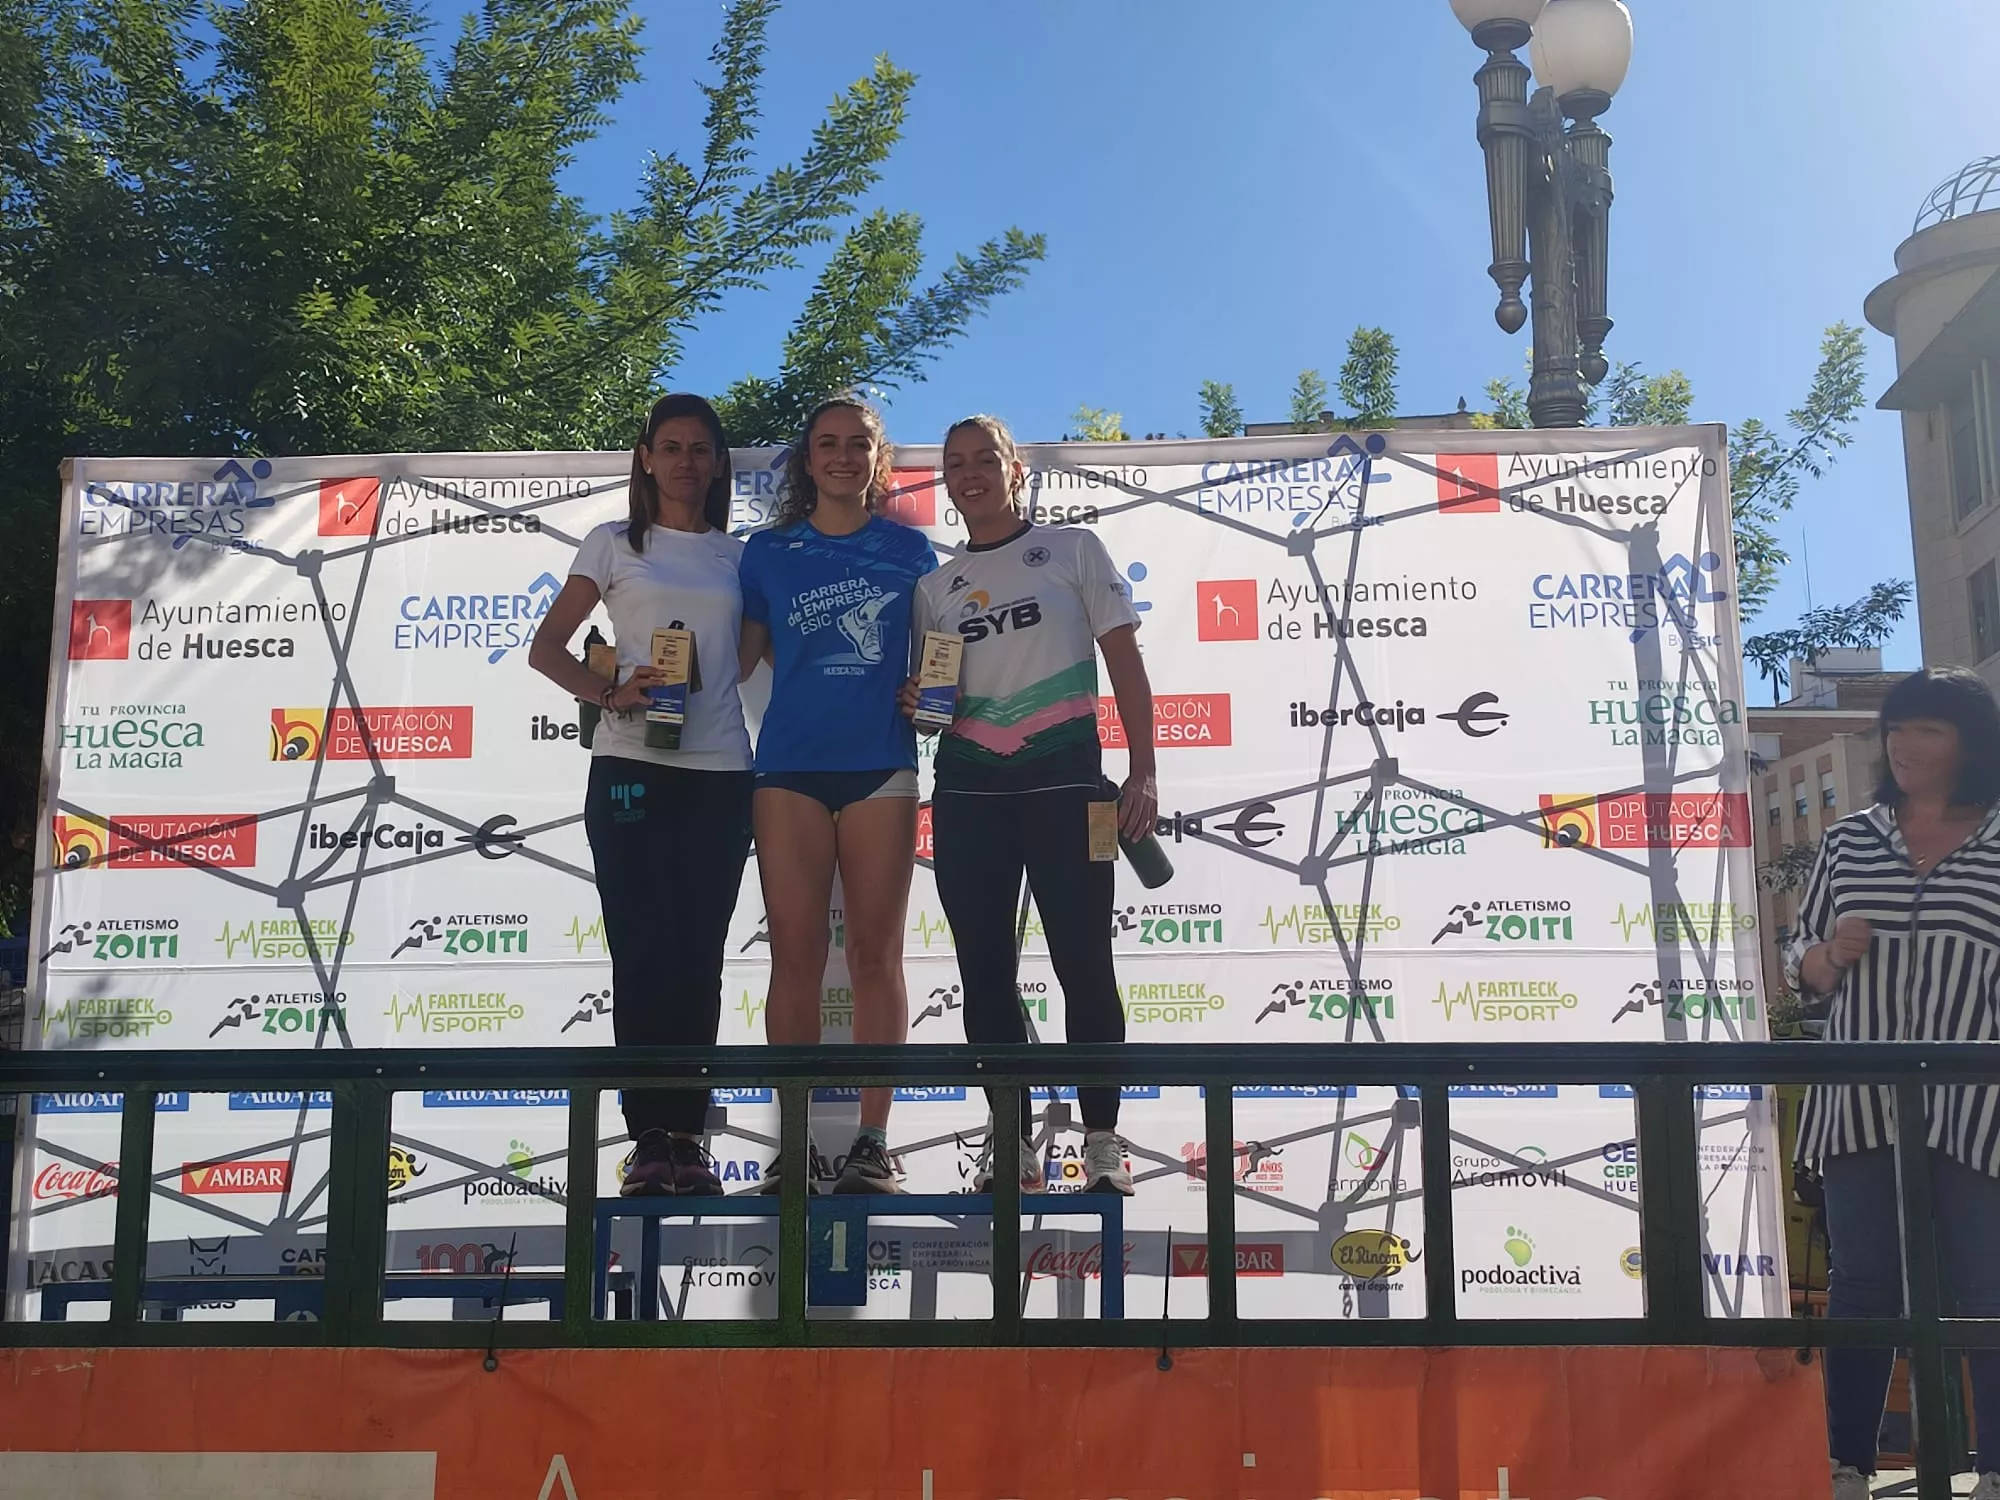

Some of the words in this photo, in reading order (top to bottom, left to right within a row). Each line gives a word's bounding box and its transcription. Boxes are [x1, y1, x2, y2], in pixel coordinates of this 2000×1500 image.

[1200, 458, 1357, 486] CARRERA
[1507, 452, 1717, 483] Ayuntamiento
[1028, 467, 1147, 489] amiento
[86, 481, 241, 507] CARRERA
[387, 475, 592, 505] Ayuntamiento
[1198, 484, 1363, 514] EMPRESAS
[1508, 491, 1543, 515] de
[1555, 487, 1667, 515] Huesca
[80, 508, 245, 535] EMPRESAS
[386, 511, 418, 535] de
[430, 509, 541, 534] Huesca
[798, 577, 870, 604] CARRERA
[1267, 576, 1477, 612] Ayuntamiento
[1532, 572, 1694, 601] CARRERA
[140, 597, 347, 631] Ayuntamiento
[787, 612, 802, 627] de
[803, 586, 883, 619] EMPRESAS
[1529, 601, 1699, 632] EMPRESAS
[800, 613, 832, 635] ESIC
[958, 602, 1042, 643] SYB
[1267, 613, 1301, 640] de
[1314, 612, 1427, 639] Huesca
[395, 622, 536, 649] EMPRESA
[138, 634, 172, 660] de
[183, 633, 294, 659] Huesca
[335, 712, 454, 733] DIPUTACIÓN
[1290, 701, 1425, 732] iberCaja
[335, 736, 363, 754] DE
[368, 735, 453, 753] HUESCA
[1608, 797, 1732, 820] DIPUTACIÓN
[118, 818, 237, 842] DIPUTACIÓN
[309, 823, 443, 854] iberCaja
[1609, 823, 1637, 841] DE
[1644, 822, 1734, 841] HUESCA
[117, 845, 144, 863] DE
[150, 843, 236, 862] HUESCA
[1141, 904, 1222, 915] ATLETISMO
[1303, 903, 1383, 921] FARTLECK
[1487, 901, 1571, 912] ATLETISMO
[1657, 903, 1737, 920] FARTLECK
[97, 920, 180, 931] ATLETISMO
[261, 920, 337, 936] FARTLECK
[446, 914, 528, 927] ATLETISMO
[1486, 915, 1573, 942] ZOITI
[444, 928, 528, 955] ZOITI
[1139, 918, 1223, 945] ZOITI
[1307, 926, 1384, 944] SPORT
[1662, 925, 1740, 944] SPORT
[93, 935, 179, 960] ZOITI
[263, 940, 335, 959] SPORT
[1129, 983, 1205, 999] FARTLECK
[1310, 979, 1394, 991] ATLETISMO
[1478, 981, 1559, 998] FARTLECK
[1667, 979, 1754, 991] ATLETISMO
[77, 998, 155, 1015] FARTLECK
[266, 993, 347, 1004] ATLETISMO
[429, 993, 505, 1009] FARTLECK
[1307, 994, 1394, 1020] ZOITI
[1666, 994, 1755, 1020] ZOITI
[262, 1008, 347, 1034] ZOITI
[1134, 1006, 1207, 1023] SPORT
[1483, 1003, 1561, 1022] SPORT
[79, 1018, 154, 1038] SPORT
[431, 1014, 506, 1032] SPORT
[1453, 1155, 1500, 1169] Grupo
[1601, 1143, 1636, 1163] CE
[1260, 1161, 1282, 1173] AÑOS
[1603, 1165, 1636, 1178] CEP
[209, 1168, 284, 1187] AMBAR
[1451, 1168, 1566, 1187] Aramovil
[1604, 1181, 1637, 1192] HUE
[464, 1176, 568, 1205] podoactiv
[824, 1221, 848, 1272] 1
[1340, 1245, 1354, 1264] El
[682, 1256, 728, 1268] Grupo
[680, 1271, 776, 1287] Aramov
[869, 1279, 901, 1290] SCA
[1357, 1281, 1366, 1291] el
[1367, 1281, 1404, 1292] deporte
[1461, 1264, 1581, 1293] podoactiva
